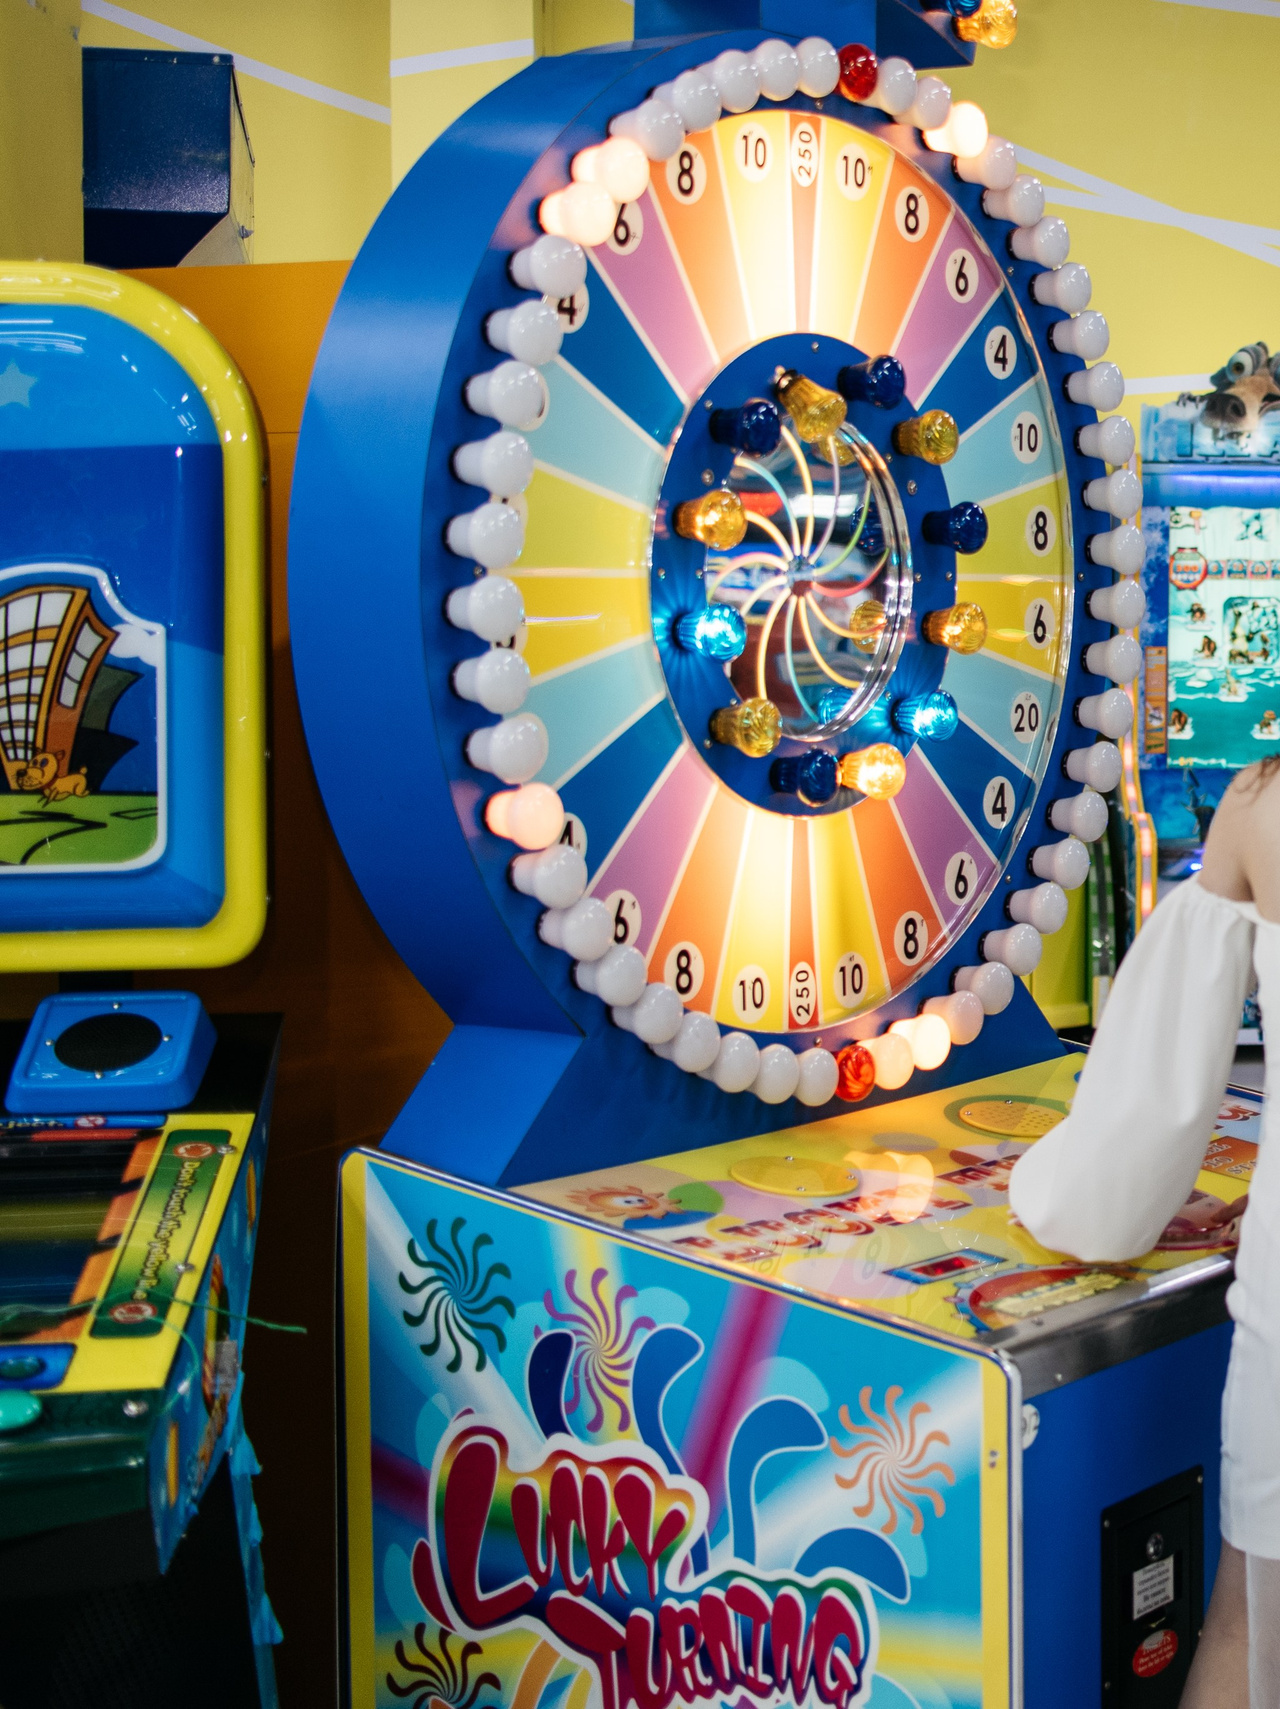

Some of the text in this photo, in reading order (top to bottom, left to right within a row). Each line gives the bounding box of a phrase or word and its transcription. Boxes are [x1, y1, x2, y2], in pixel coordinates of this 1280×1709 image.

[678, 149, 695, 197] 8
[741, 137, 767, 169] 10
[797, 130, 813, 181] 250
[842, 154, 867, 187] 10
[613, 202, 630, 247] 6
[904, 192, 920, 236] 8
[954, 258, 969, 297] 6
[993, 334, 1009, 372] 4
[1016, 422, 1039, 453] 10
[1034, 510, 1049, 551] 8
[1032, 604, 1047, 643] 6
[1013, 702, 1039, 733] 20
[991, 782, 1008, 822] 4
[953, 858, 968, 900] 6
[614, 898, 630, 944] 6
[903, 917, 919, 960] 8
[676, 948, 693, 995] 8
[838, 964, 864, 996] 10
[738, 977, 766, 1011] 10
[796, 969, 811, 1017] 250
[178, 1160, 201, 1187] Don't
[164, 1187, 191, 1220] touch
[443, 1440, 690, 1626] LUCKY
